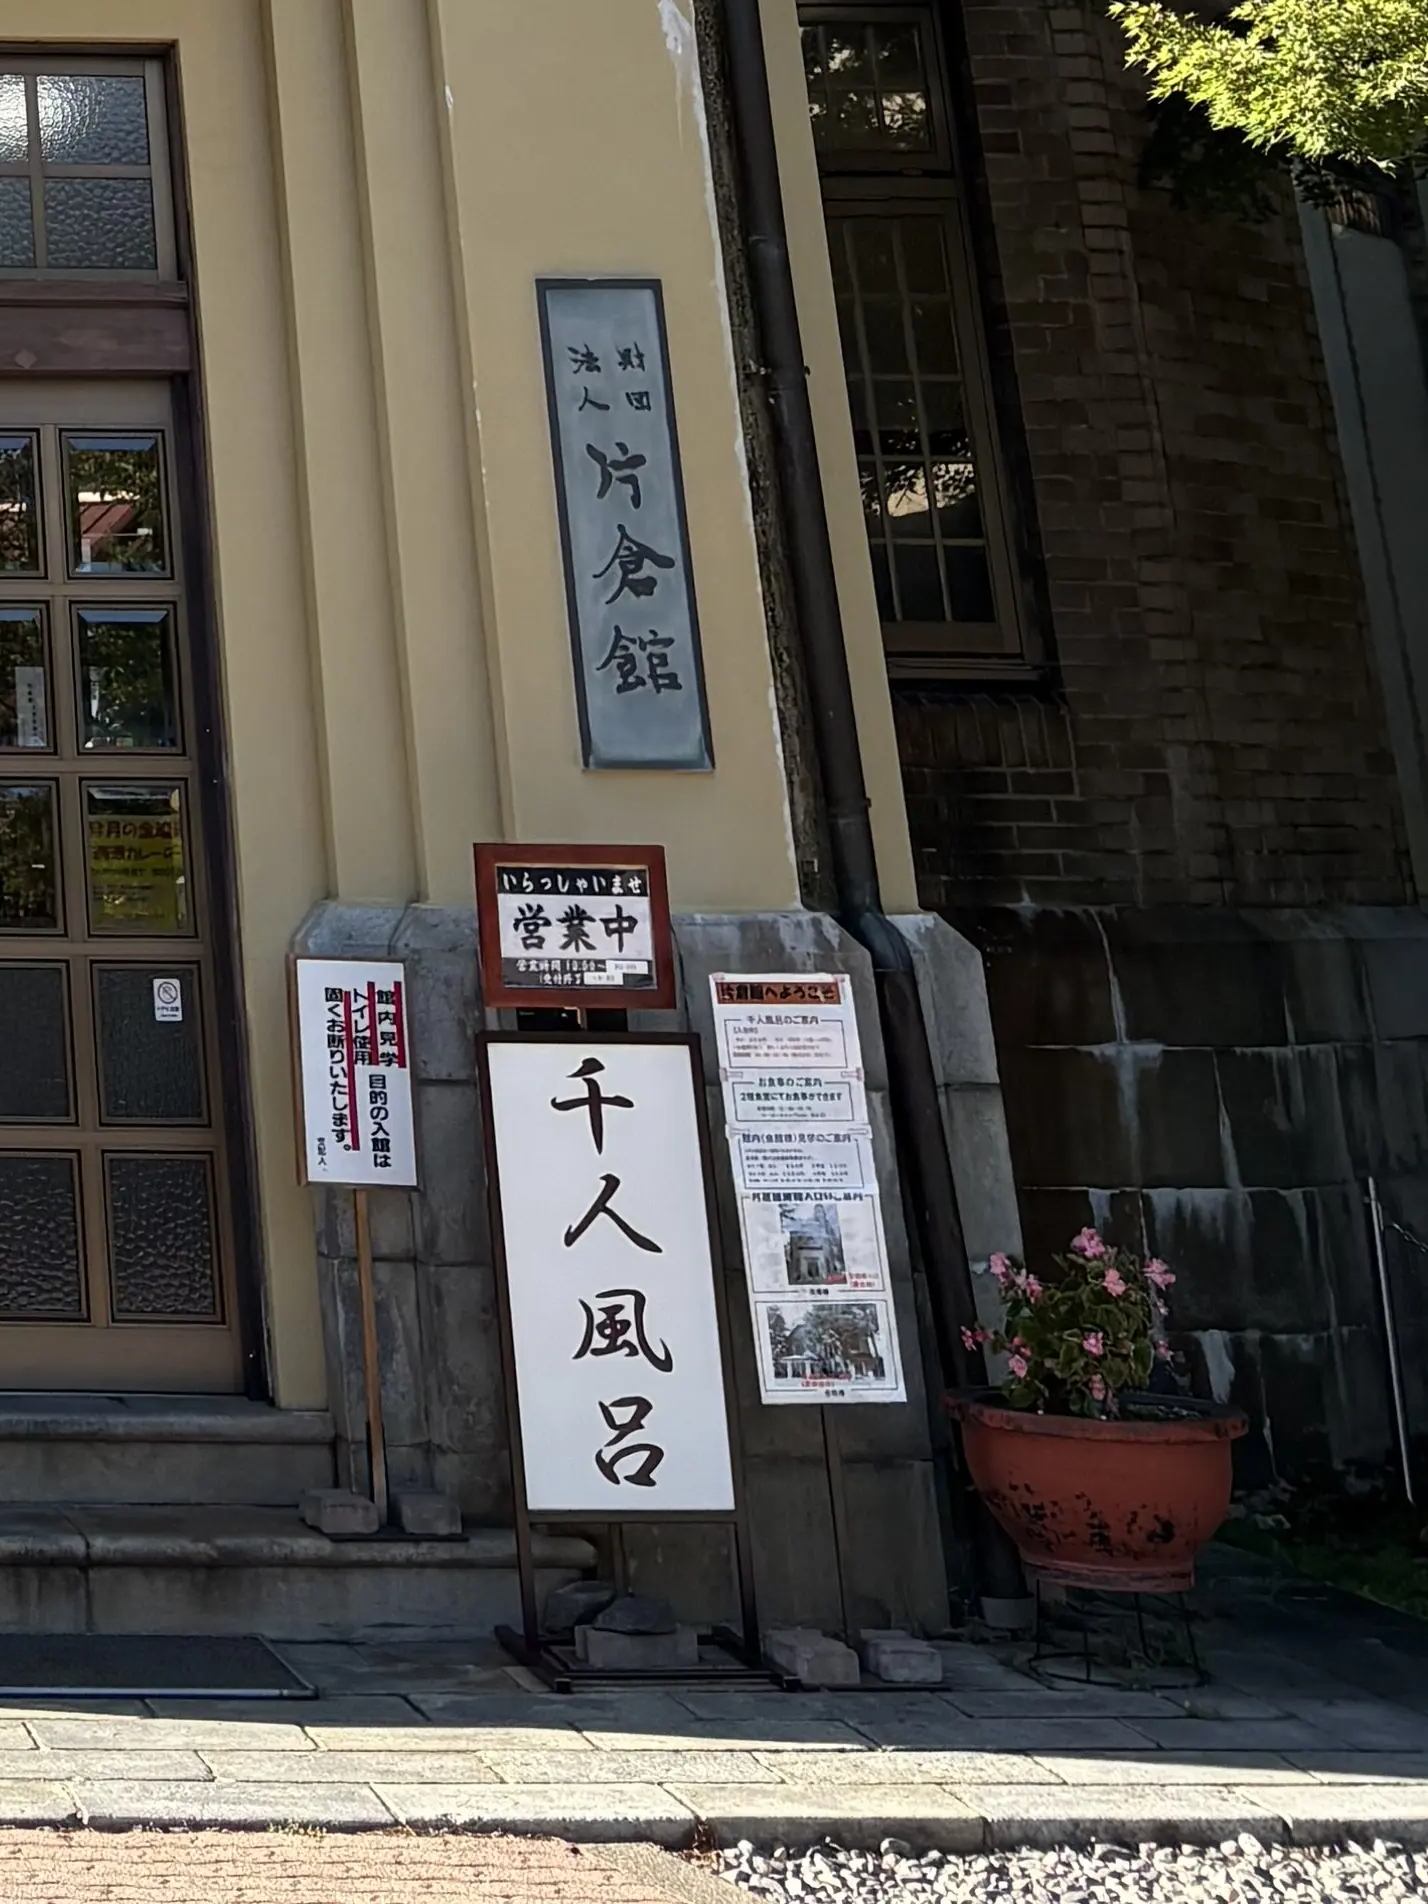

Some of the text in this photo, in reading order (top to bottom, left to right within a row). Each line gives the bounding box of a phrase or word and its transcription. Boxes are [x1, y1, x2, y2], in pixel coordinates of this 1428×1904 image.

[566, 342, 611, 412] 法人
[585, 441, 683, 694] 片倉館
[503, 872, 642, 894] いらっしゃいませ
[513, 903, 638, 953] 営業中
[516, 960, 561, 972] 営業時間
[352, 988, 373, 1066] トイレ使用
[377, 989, 398, 1067] 館内見学
[324, 987, 352, 1151] 固くお断りいたします。
[369, 1074, 392, 1168] 目的の入館は
[550, 1057, 674, 1488] 千人風呂
